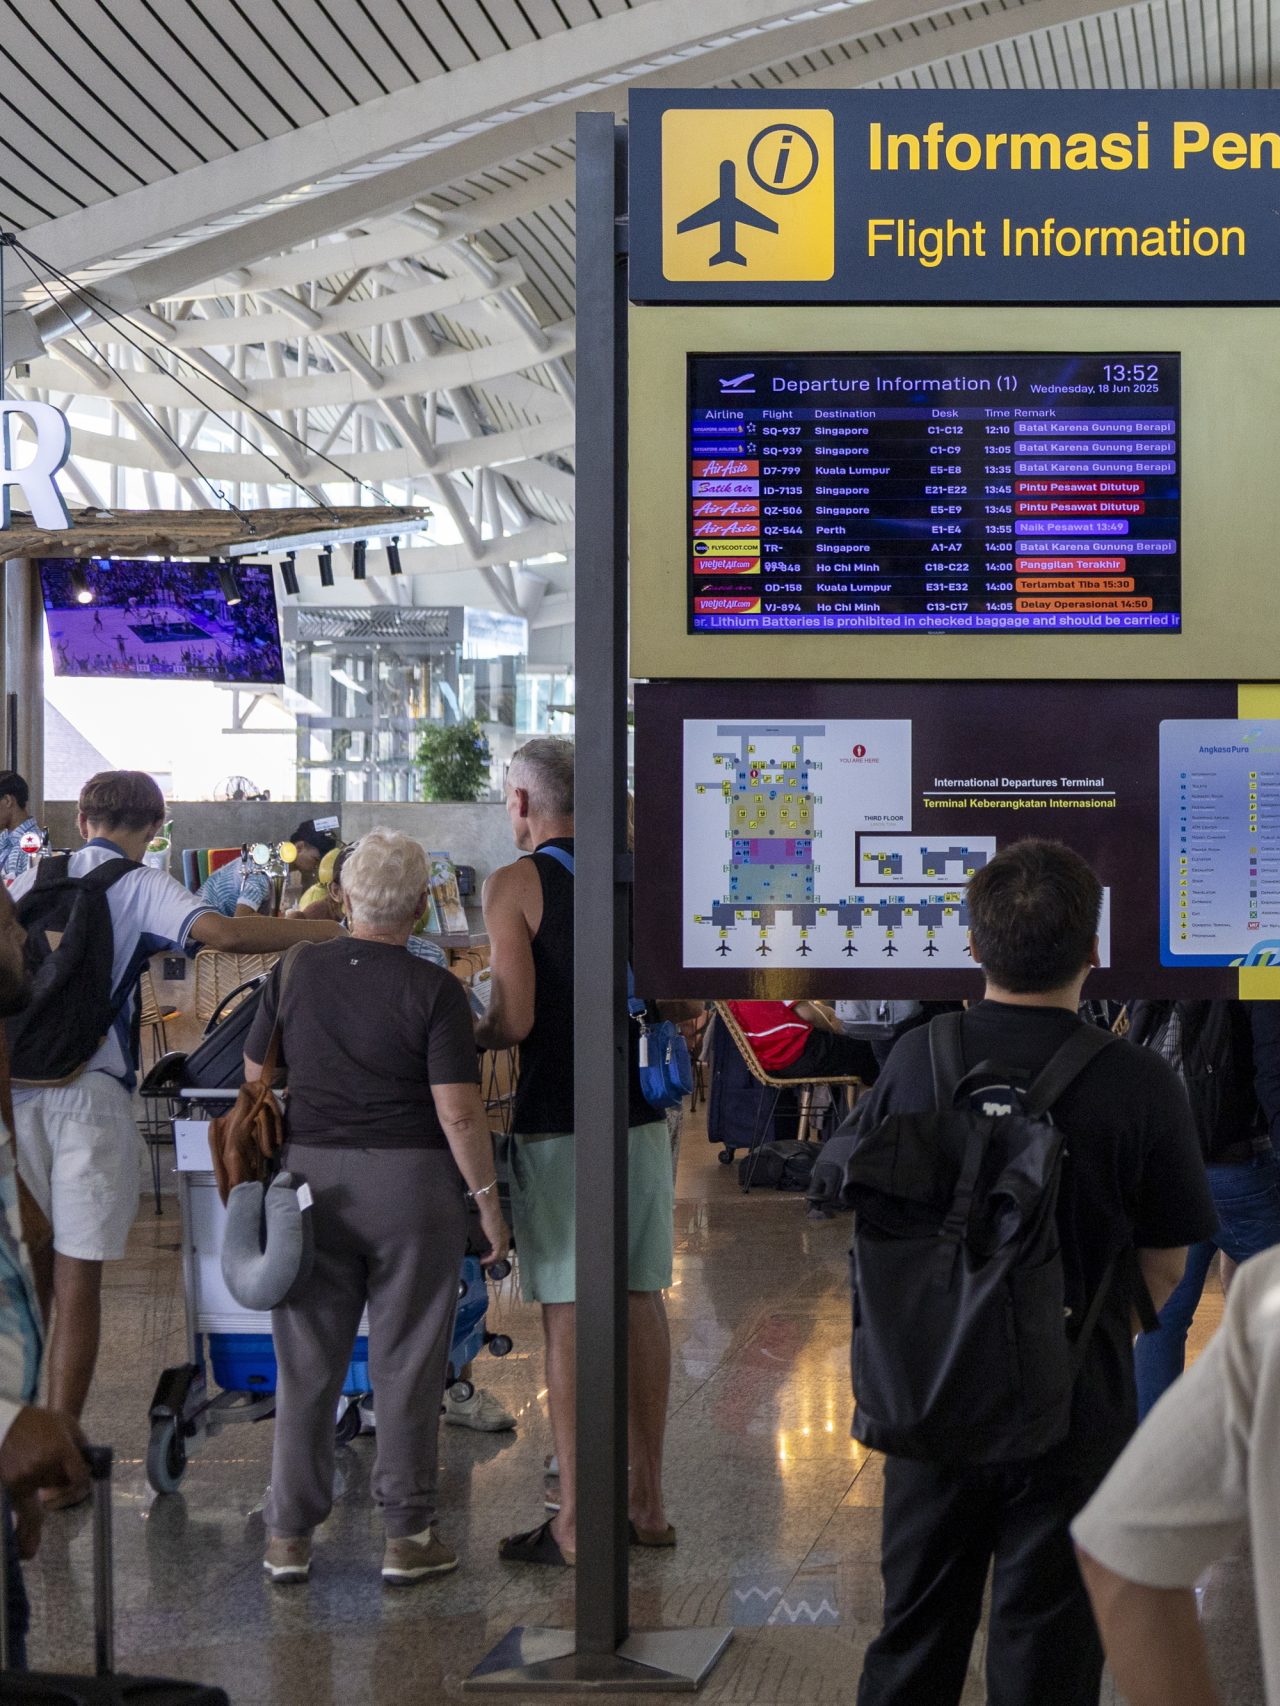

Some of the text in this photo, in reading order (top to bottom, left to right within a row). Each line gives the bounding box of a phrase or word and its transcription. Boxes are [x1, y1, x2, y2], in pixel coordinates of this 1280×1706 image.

[870, 122, 1151, 170] Informasi
[869, 218, 1245, 267] Flight Information
[1104, 365, 1158, 381] 13:52
[773, 376, 1017, 393] Departure Information (1)
[1030, 385, 1095, 394] Wednesday,
[1098, 384, 1109, 392] 18
[1134, 384, 1158, 392] 2025
[706, 410, 743, 419] Airline
[763, 410, 792, 419] Flight
[815, 410, 875, 418] Destination
[932, 409, 958, 417] Desk
[985, 409, 1010, 417] Time
[763, 427, 801, 435] SQ-937
[815, 427, 868, 436] Singapore
[928, 426, 963, 434] C1-C12
[986, 426, 1009, 434] 12:10
[1092, 424, 1132, 432] Gunung
[1136, 424, 1170, 432] Berapi
[763, 447, 802, 456] SQ-939
[815, 447, 869, 455] Singapore
[930, 446, 961, 454] C1-C9
[849, 467, 890, 475] Lumpur
[931, 466, 961, 474] E5-E8
[698, 482, 732, 493] Batik
[816, 487, 869, 495] Singapore
[925, 486, 967, 494] E21-E22
[1051, 483, 1097, 491] Pesawat
[1100, 483, 1139, 492] Ditutup
[764, 527, 802, 535] QZ-544
[816, 526, 845, 534] Perth
[764, 544, 783, 552] TR-
[711, 617, 758, 626] Lithium
[763, 617, 820, 626] Batteries
[824, 617, 835, 626] is
[838, 616, 900, 629] prohibited
[905, 616, 915, 626] in
[919, 616, 972, 625] checked
[976, 616, 1030, 627] baggage
[1033, 616, 1057, 625] and
[1059, 616, 1103, 625] should
[1106, 616, 1120, 625] be
[1124, 615, 1167, 625] carried
[935, 778, 1104, 788] International Departures Terminal
[923, 799, 1115, 809] Terminal Keberangkatan Internasional
